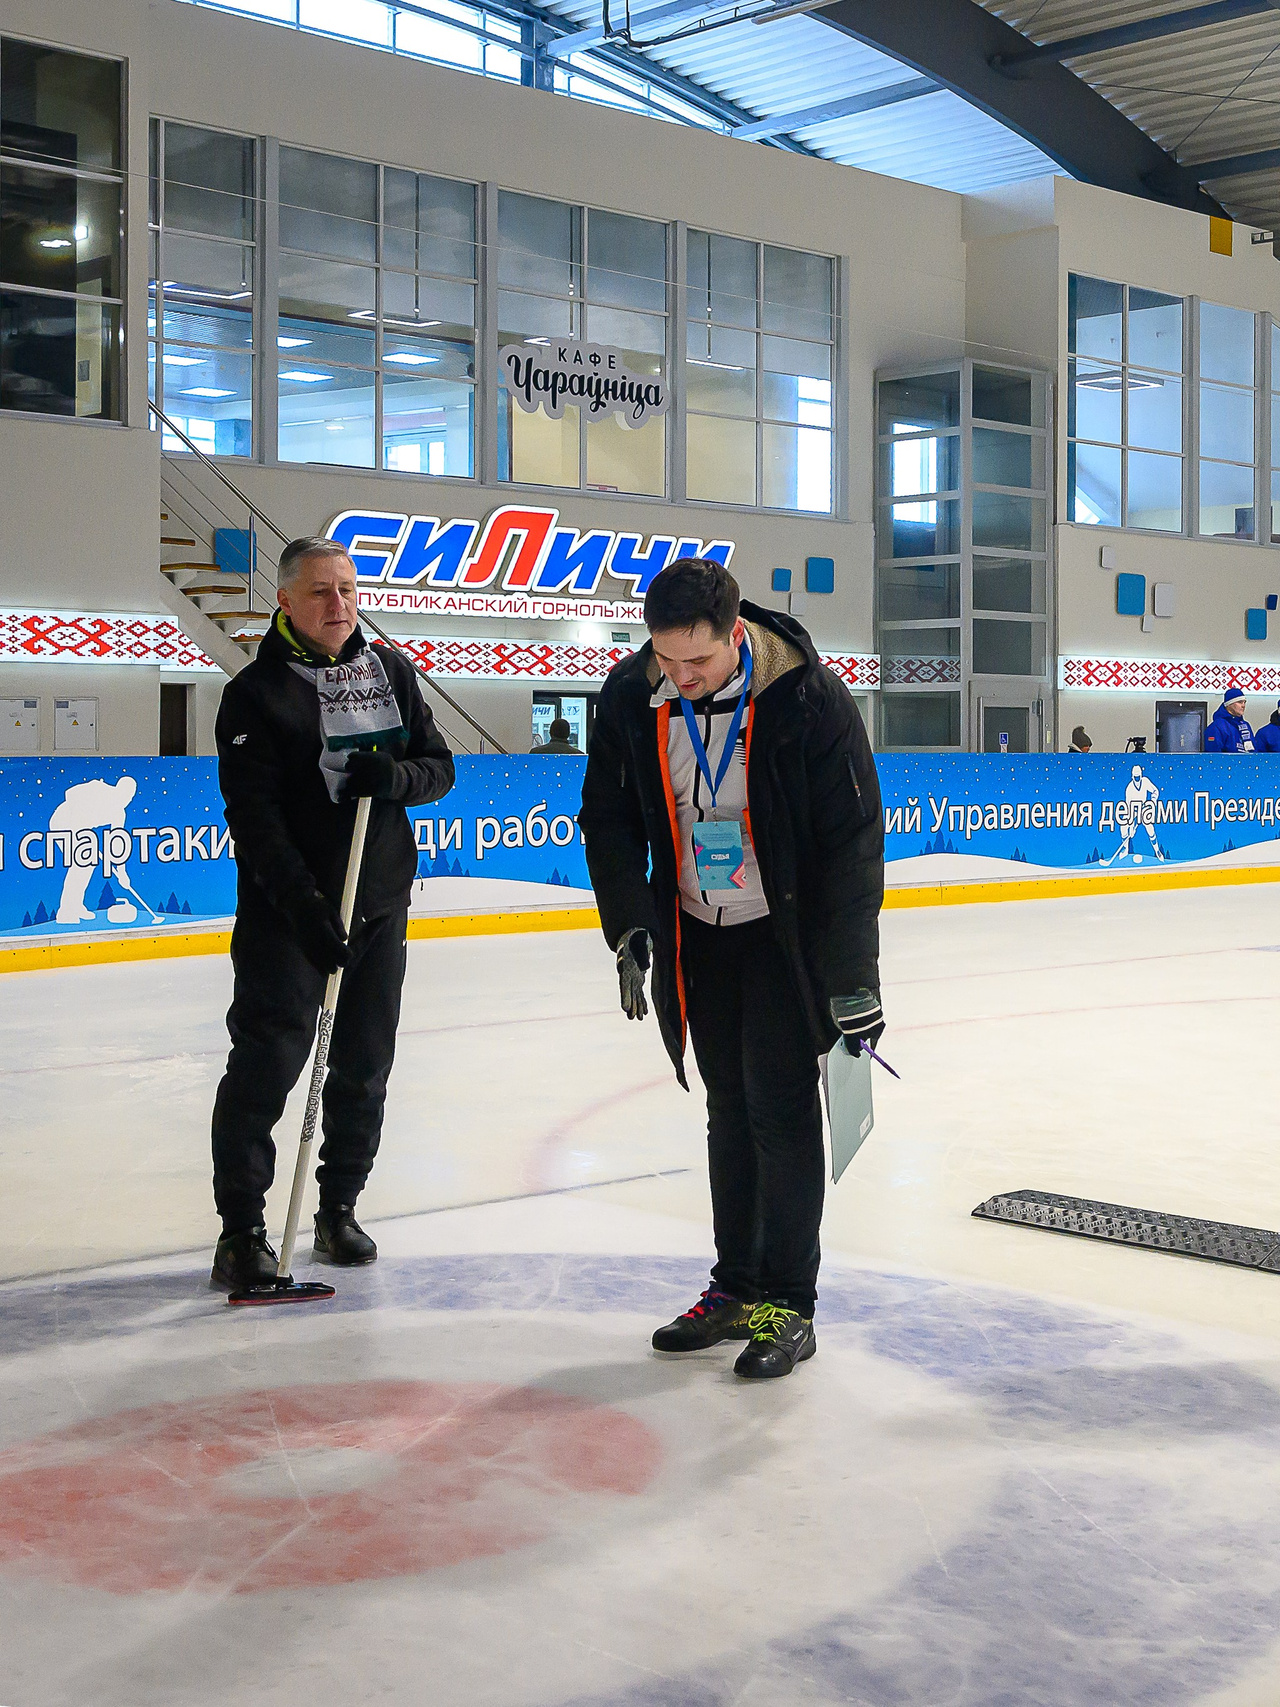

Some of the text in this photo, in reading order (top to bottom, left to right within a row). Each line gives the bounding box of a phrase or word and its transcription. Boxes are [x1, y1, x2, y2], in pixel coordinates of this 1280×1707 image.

[558, 347, 616, 369] КАФЕ
[506, 354, 664, 420] Чараўніца
[358, 592, 527, 614] ПУБЛИКАНСКИЙ
[19, 825, 235, 877] спартаки
[414, 818, 463, 859] ди
[476, 802, 586, 860] рабо
[884, 796, 921, 834] ий
[928, 796, 1093, 840] Управления
[1098, 799, 1188, 832] делами
